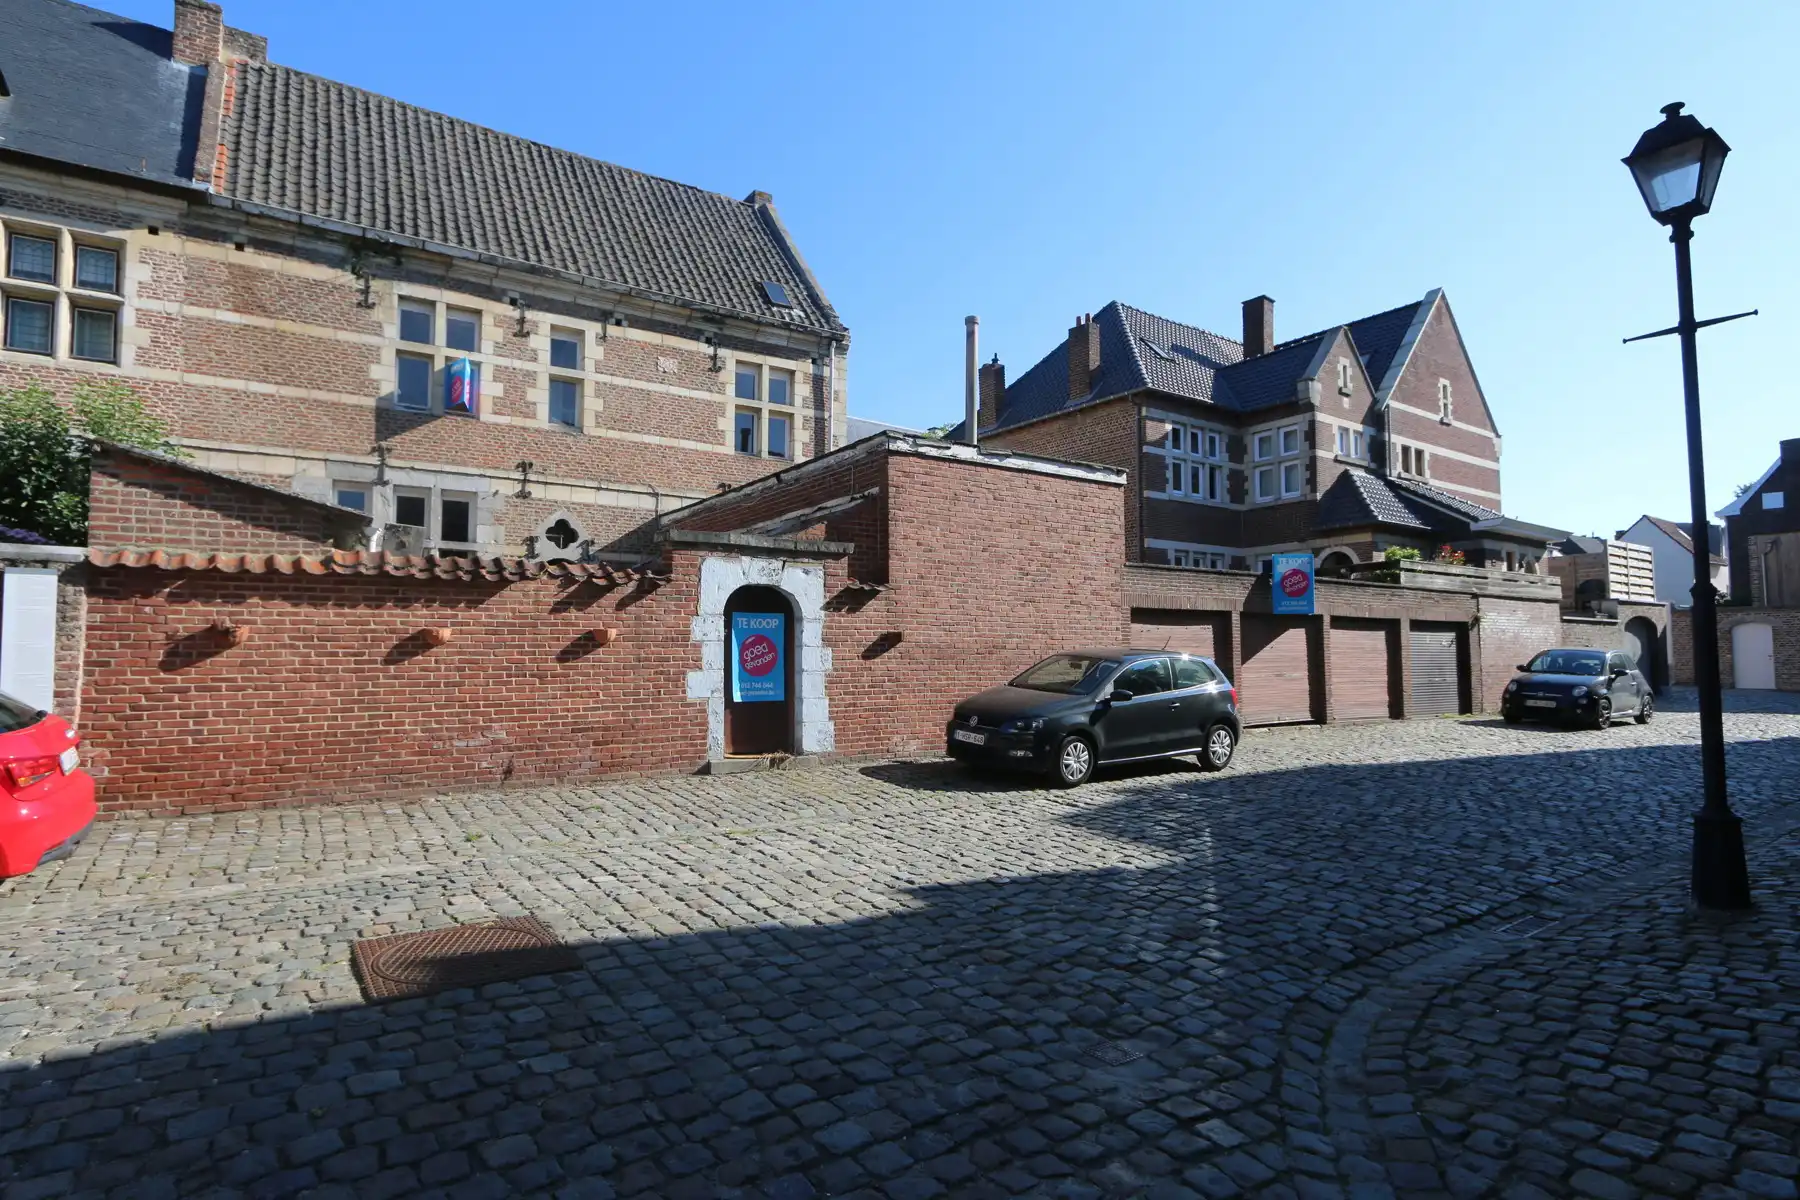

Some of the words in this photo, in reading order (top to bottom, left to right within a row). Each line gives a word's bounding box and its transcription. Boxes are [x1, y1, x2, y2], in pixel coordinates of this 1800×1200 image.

[737, 618, 749, 629] TE
[750, 619, 779, 629] KOOP
[743, 643, 768, 662] goed
[744, 652, 776, 670] gevonden
